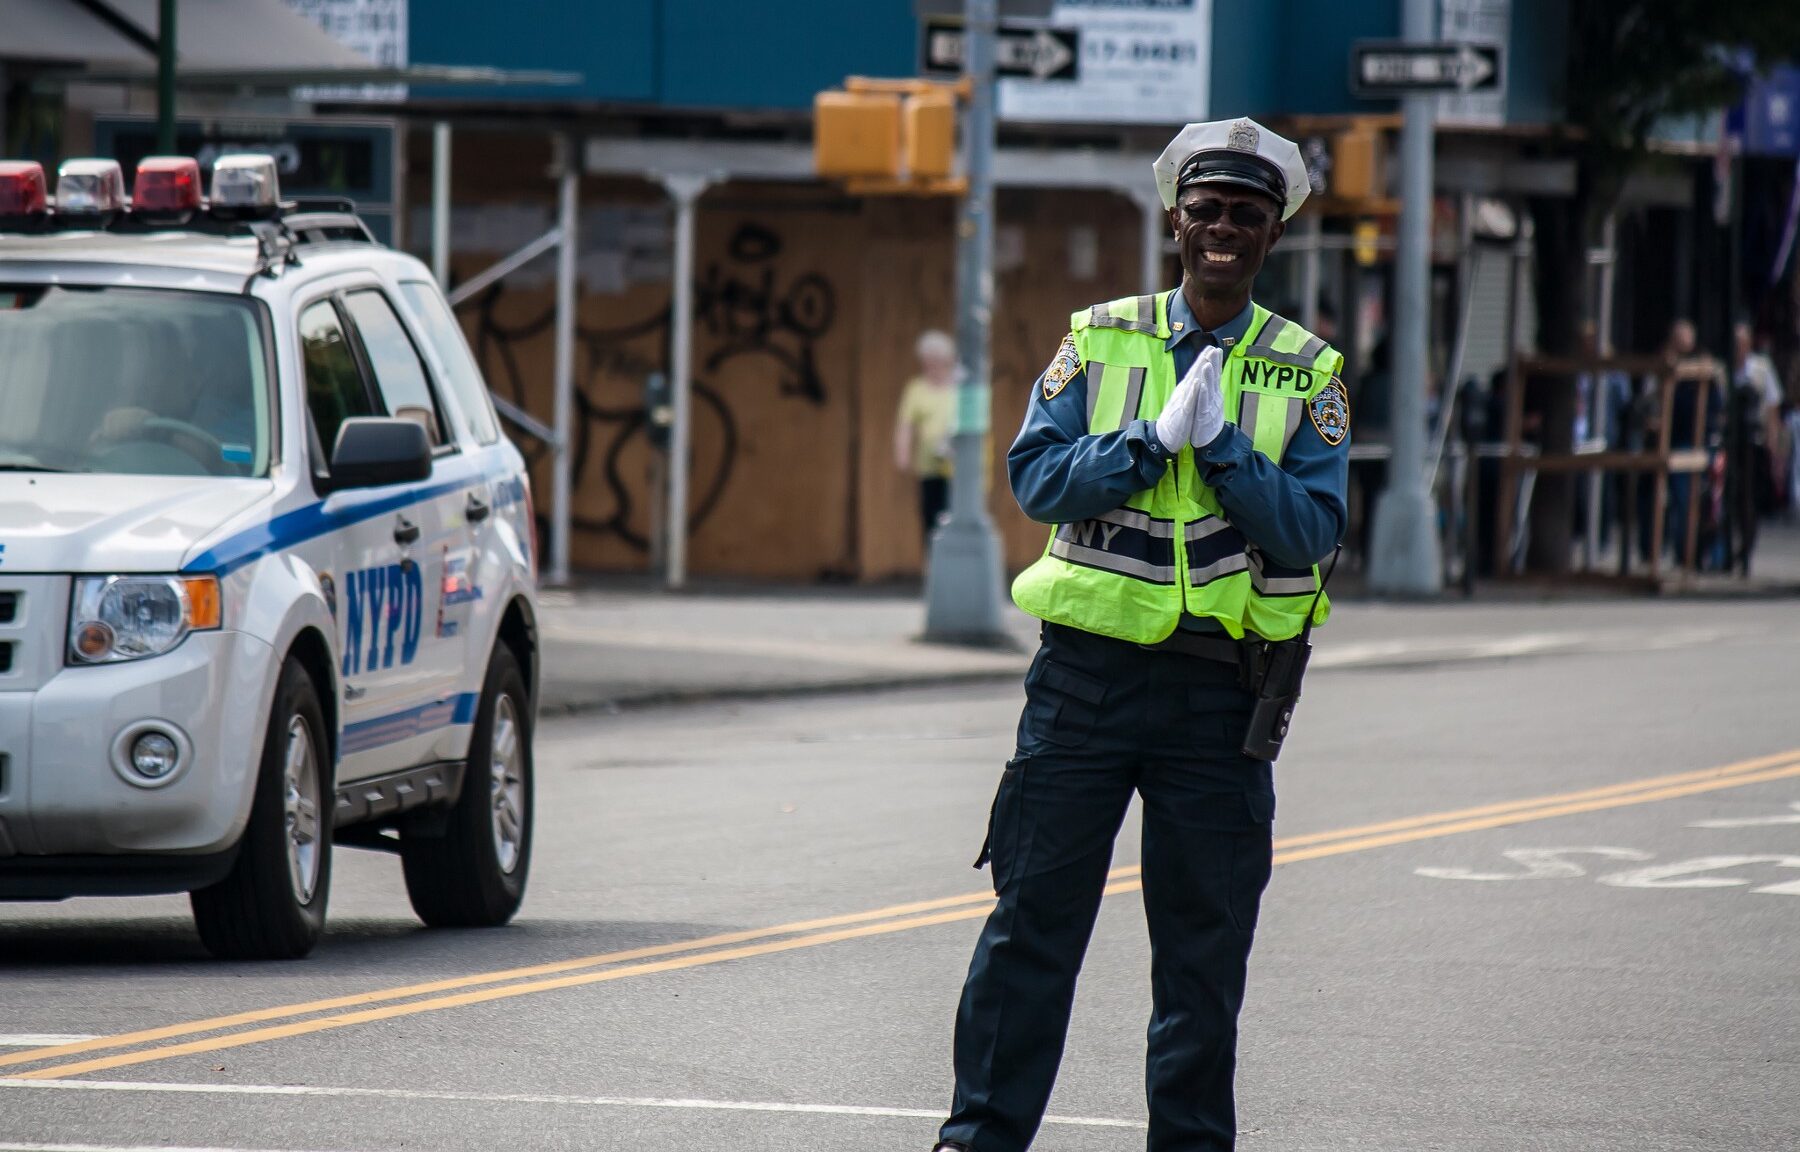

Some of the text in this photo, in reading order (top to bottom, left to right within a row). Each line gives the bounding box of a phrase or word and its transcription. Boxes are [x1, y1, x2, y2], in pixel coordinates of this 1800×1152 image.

[1240, 360, 1313, 393] NYPD
[1071, 519, 1123, 551] NY
[342, 561, 422, 676] NYPD
